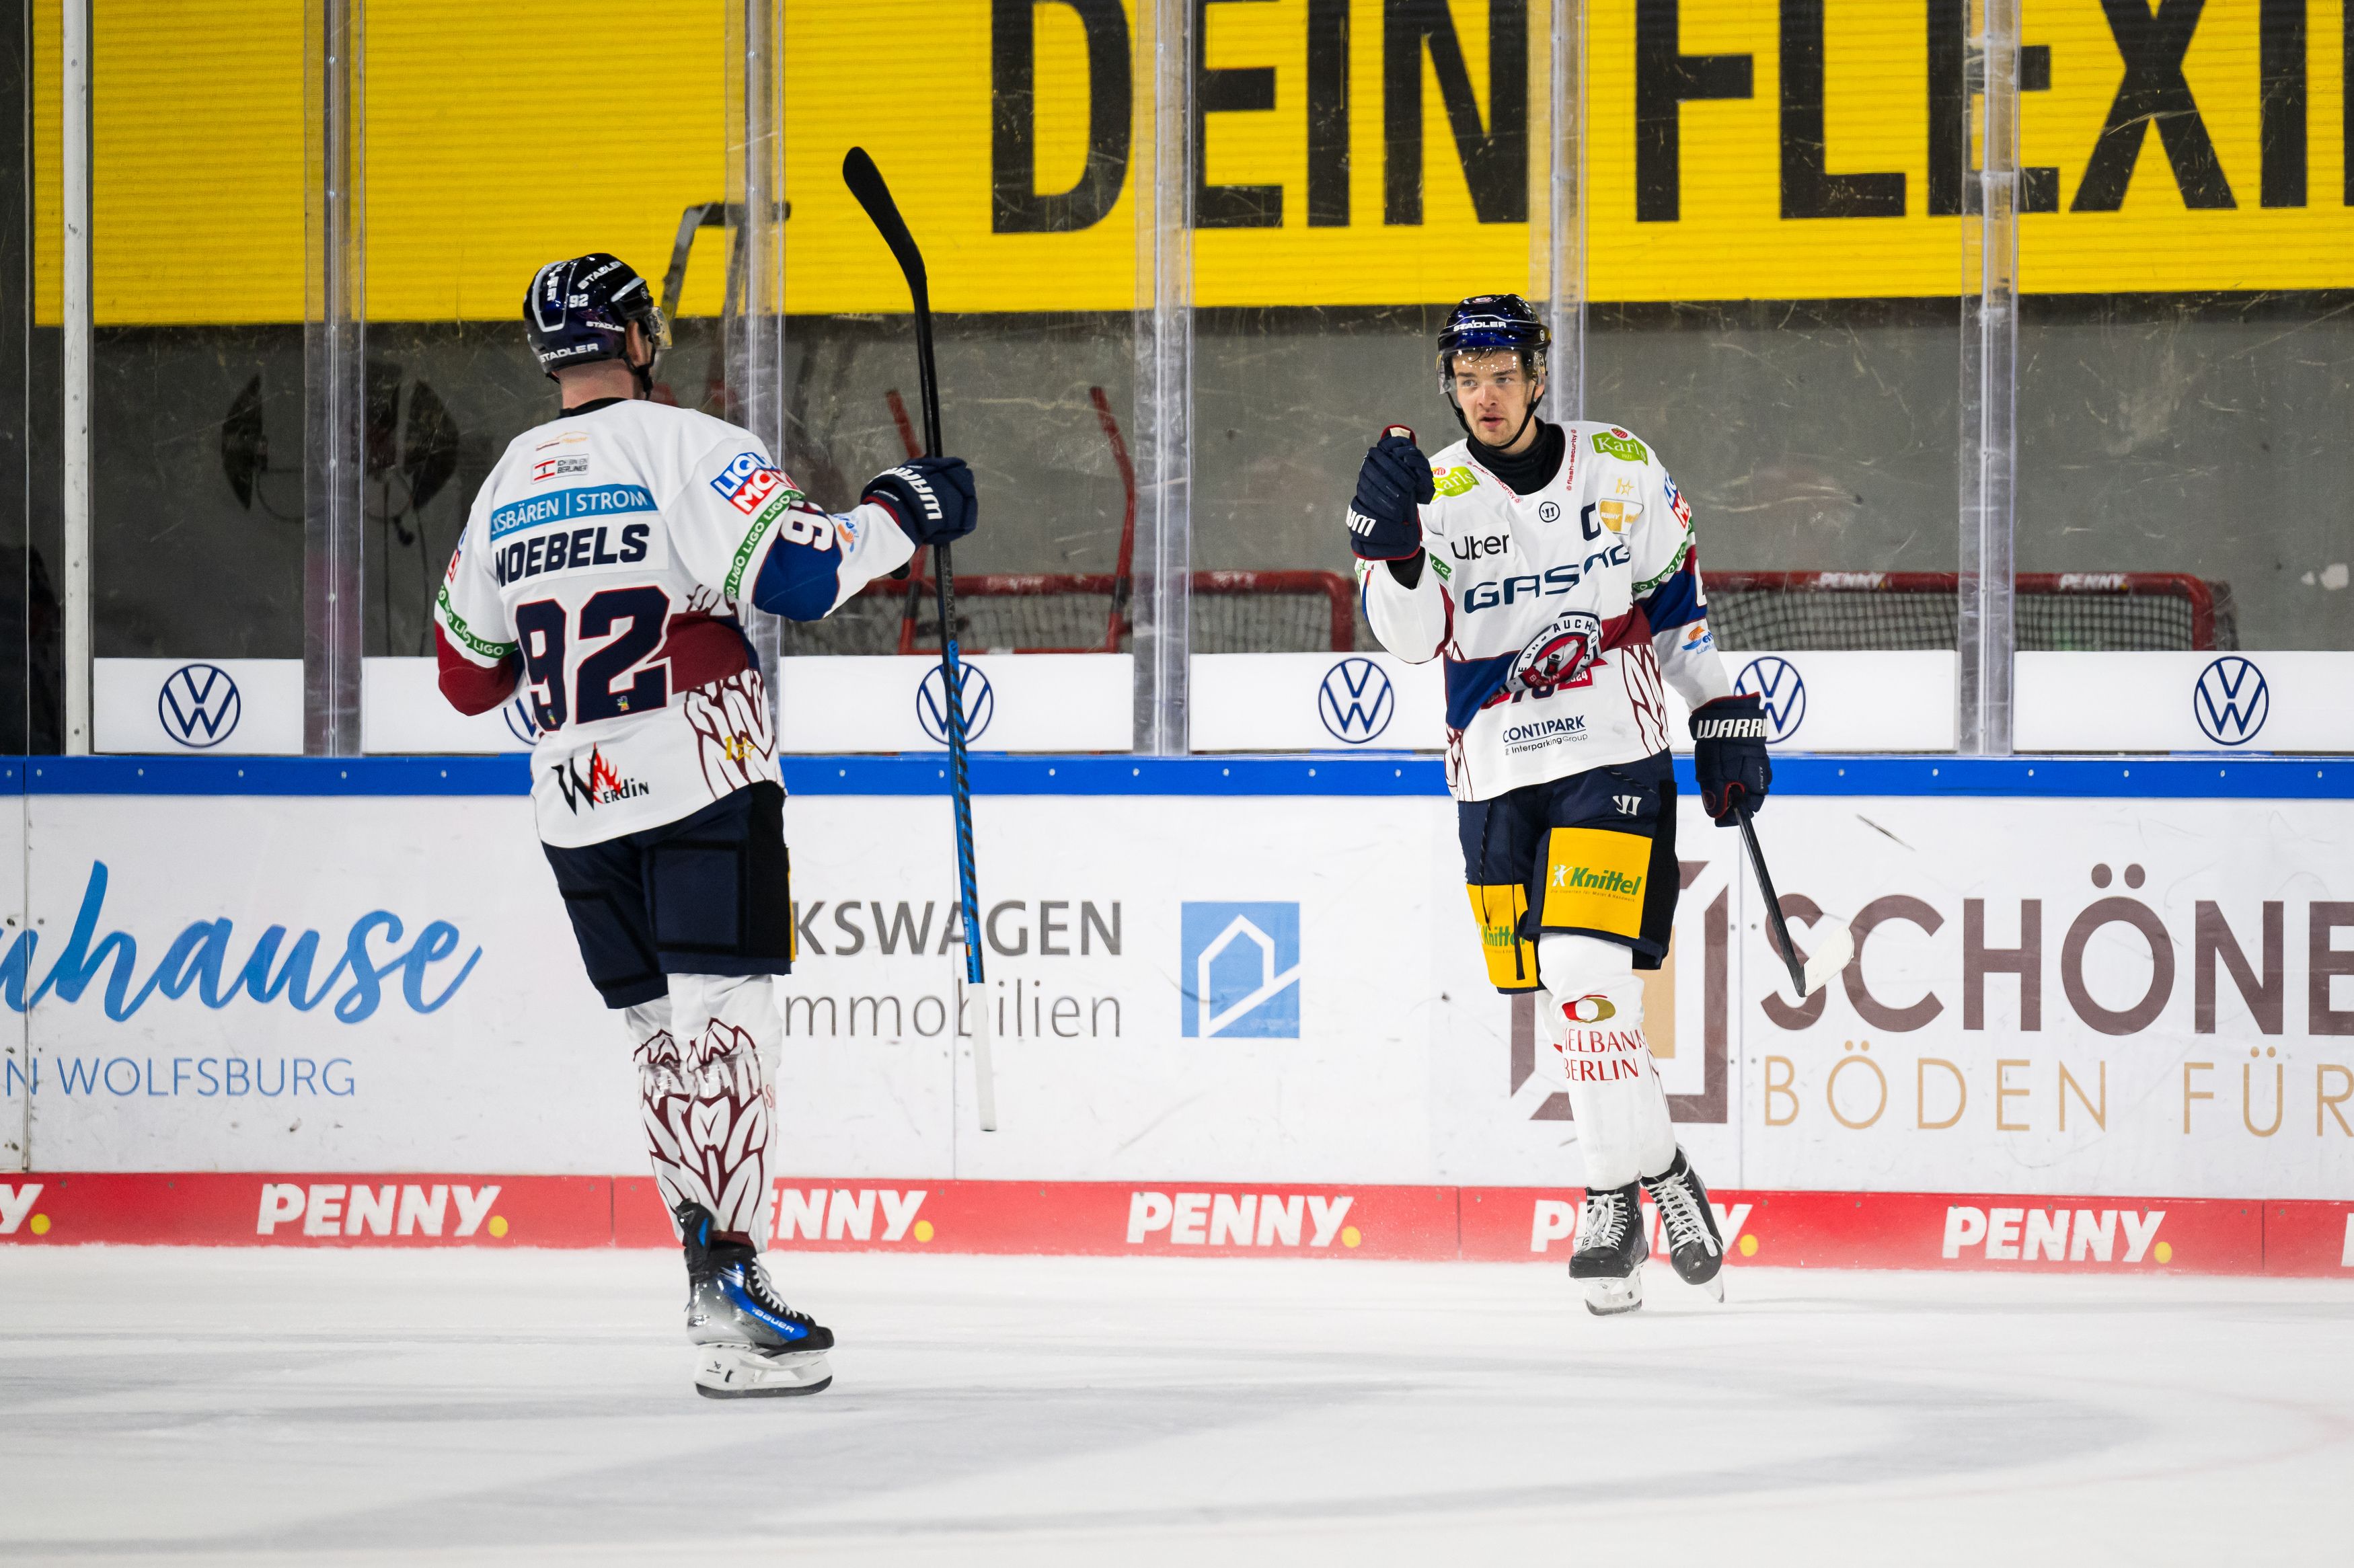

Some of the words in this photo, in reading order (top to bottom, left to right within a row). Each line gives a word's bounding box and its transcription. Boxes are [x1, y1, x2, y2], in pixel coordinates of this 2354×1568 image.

[992, 0, 1529, 233] DEIN
[1636, 0, 2354, 222] FLEXI
[577, 260, 624, 290] STADLER
[568, 293, 589, 309] 92
[585, 320, 625, 333] STADLER
[1452, 321, 1507, 333] STADLER
[539, 342, 599, 364] STADLER
[1596, 437, 1646, 462] Karls
[713, 453, 775, 499] LIQU
[1442, 471, 1476, 492] arls
[576, 489, 648, 513] STROM
[763, 494, 790, 520] LIGO
[1581, 502, 1602, 541] C
[743, 521, 765, 554] LIGO
[728, 555, 746, 585] LIGO
[1552, 619, 1594, 633] AUCH
[473, 639, 504, 656] LIGO
[515, 584, 671, 732] 92
[1503, 714, 1586, 743] CONTIPARK
[1569, 867, 1642, 896] Knittel
[792, 900, 1122, 957] KSWAGEN
[785, 978, 1121, 1038] mmobilien
[57, 1057, 355, 1097] WOLFSBURG
[1564, 1057, 1639, 1081] BERLIN
[1764, 1040, 2106, 1132] BÖDEN
[2182, 1045, 2354, 1138] FÜR
[256, 1184, 502, 1237] PENNY
[1127, 1191, 1354, 1247] PENNY
[1942, 1206, 2165, 1262] PENNY
